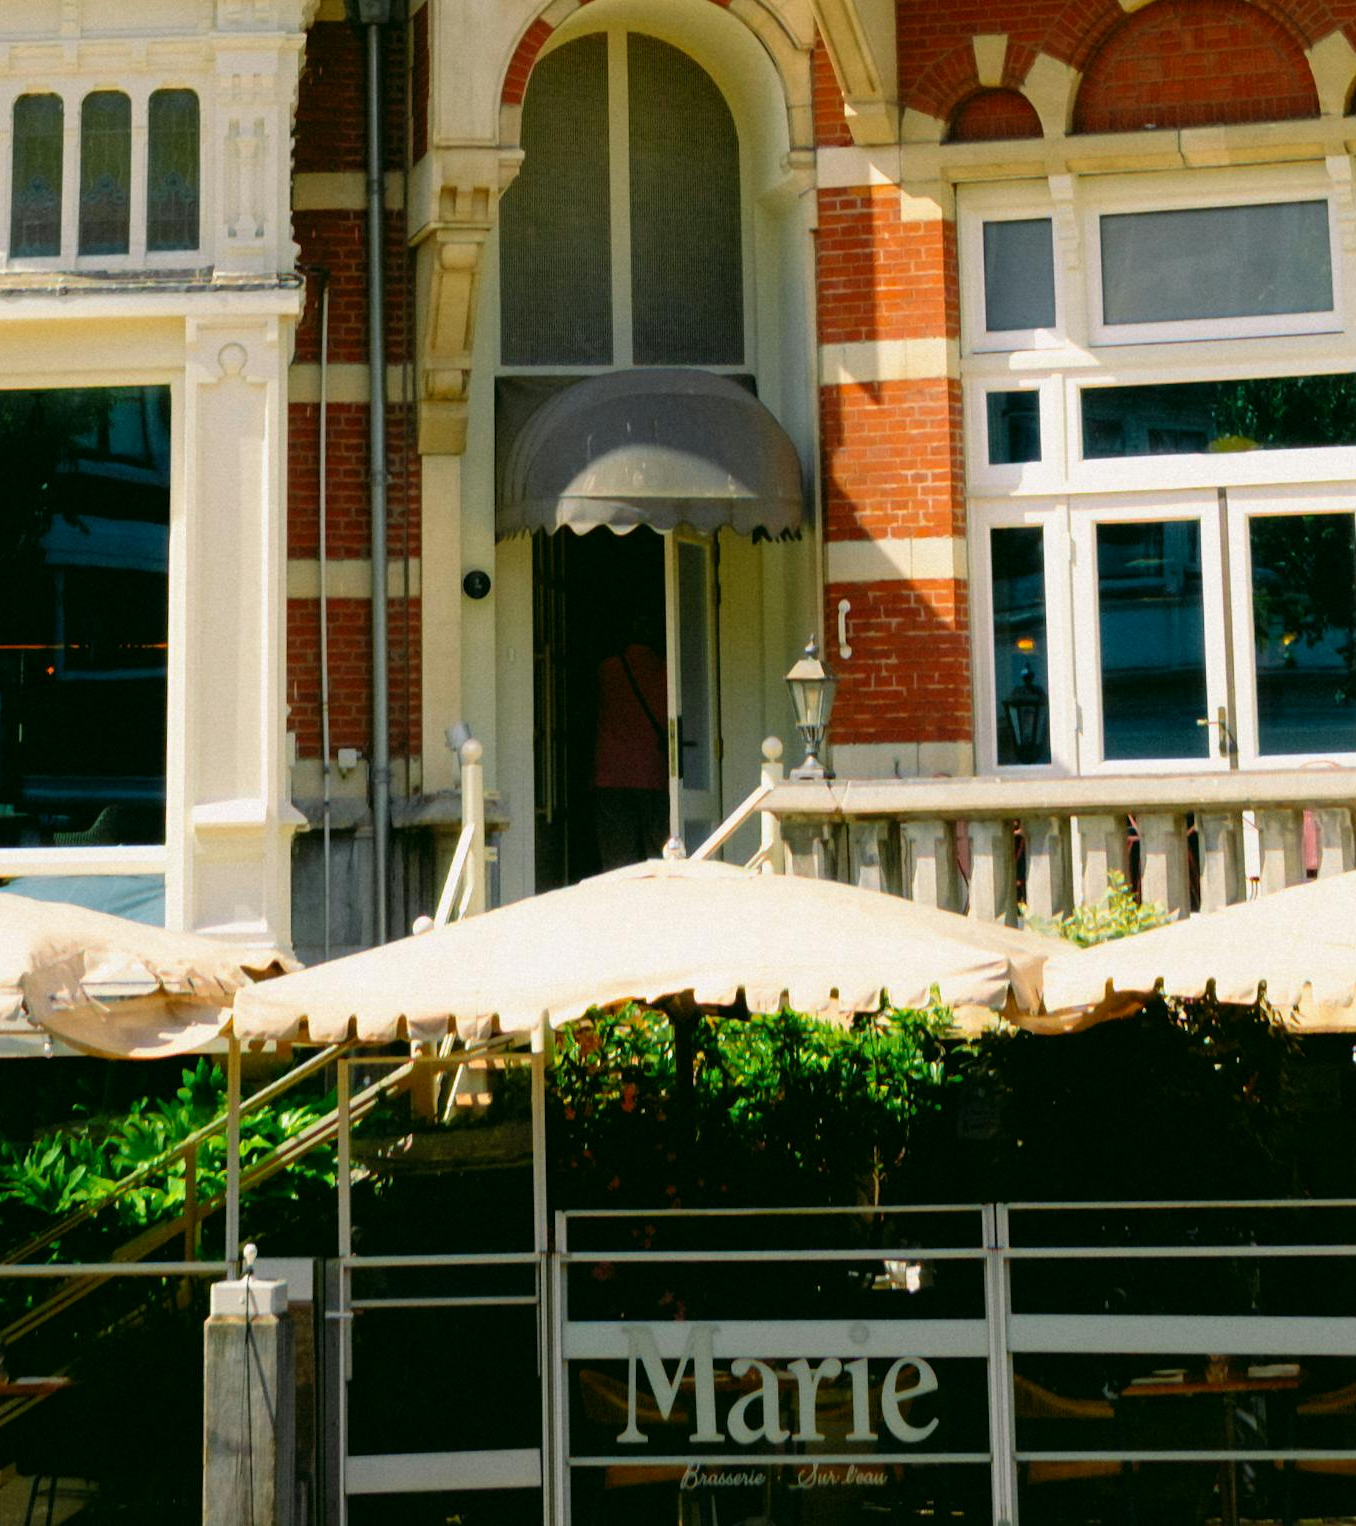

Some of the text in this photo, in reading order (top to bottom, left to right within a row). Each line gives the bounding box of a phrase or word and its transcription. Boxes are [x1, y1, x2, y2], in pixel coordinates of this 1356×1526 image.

[616, 1323, 939, 1444] Marie
[680, 1463, 888, 1489] Brasserie Sur l'eau
